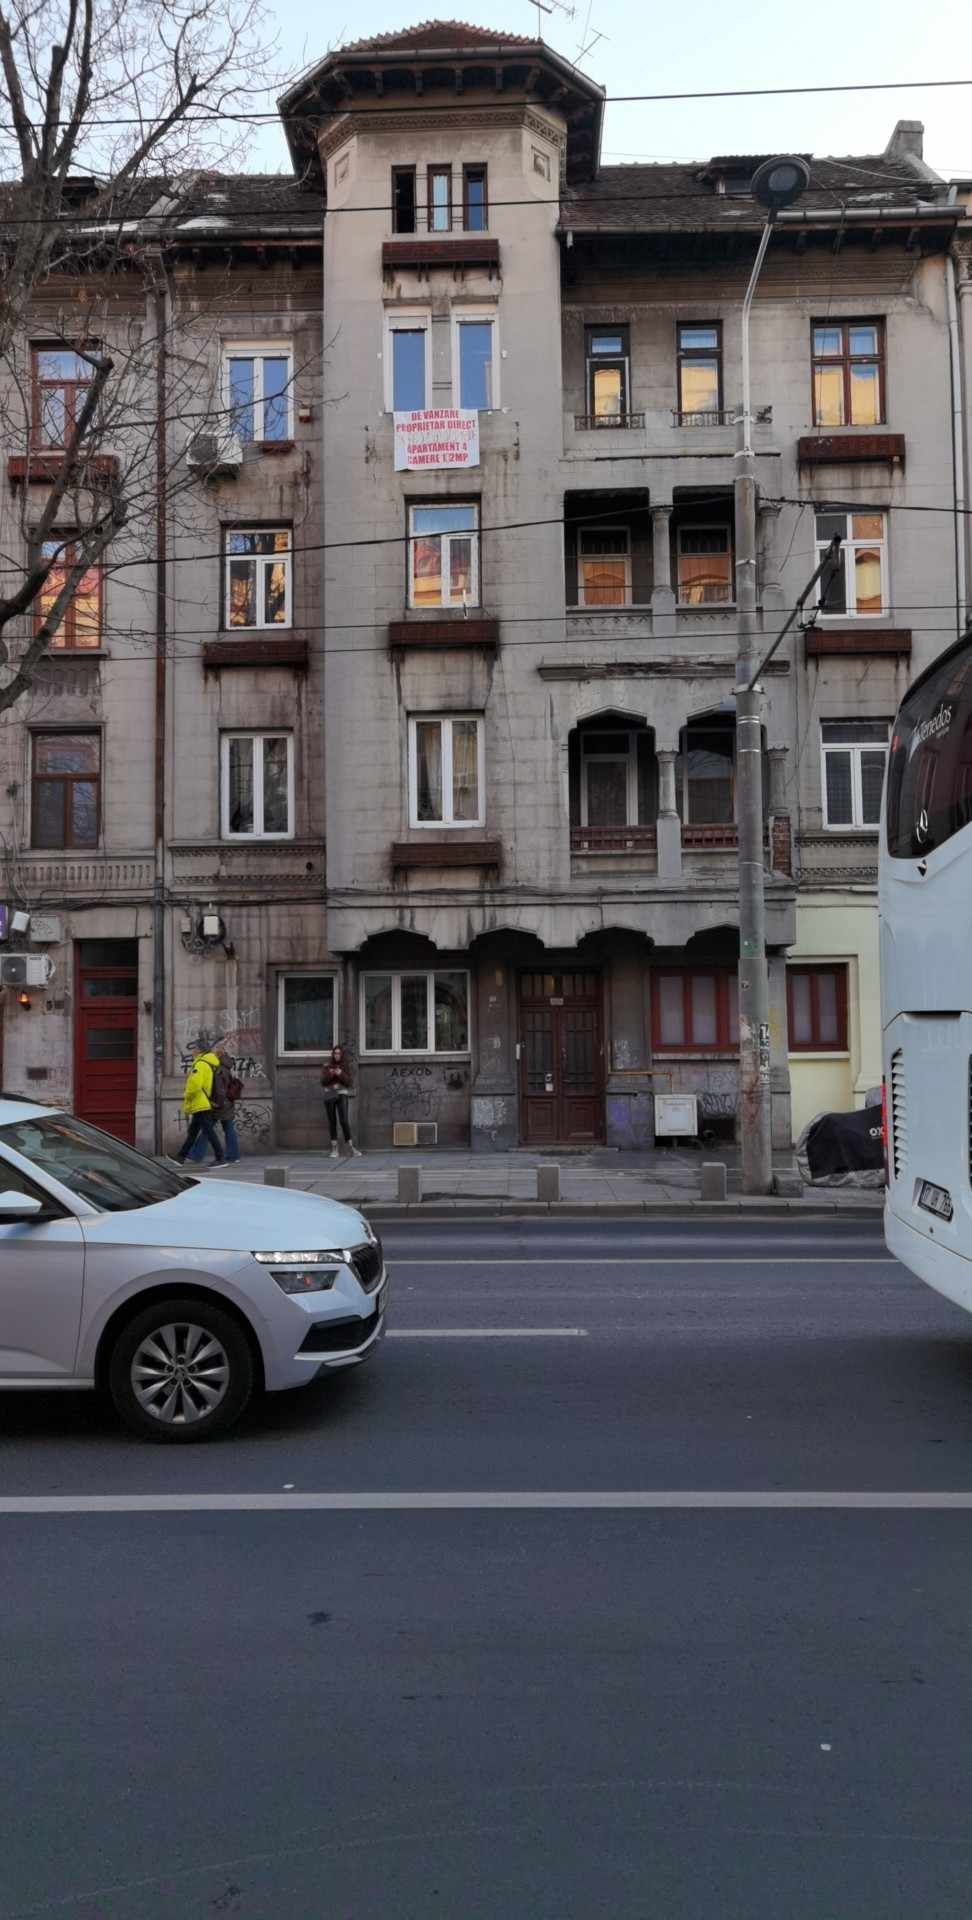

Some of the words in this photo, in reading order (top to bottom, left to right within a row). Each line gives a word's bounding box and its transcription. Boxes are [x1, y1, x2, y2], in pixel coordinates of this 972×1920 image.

[411, 412, 421, 421] DE
[423, 410, 459, 419] VANZARE
[396, 421, 445, 432] PROPRIETAR
[447, 420, 476, 430] DIRECT
[407, 442, 459, 453] APARTAMENT
[408, 455, 440, 464] CAMERE
